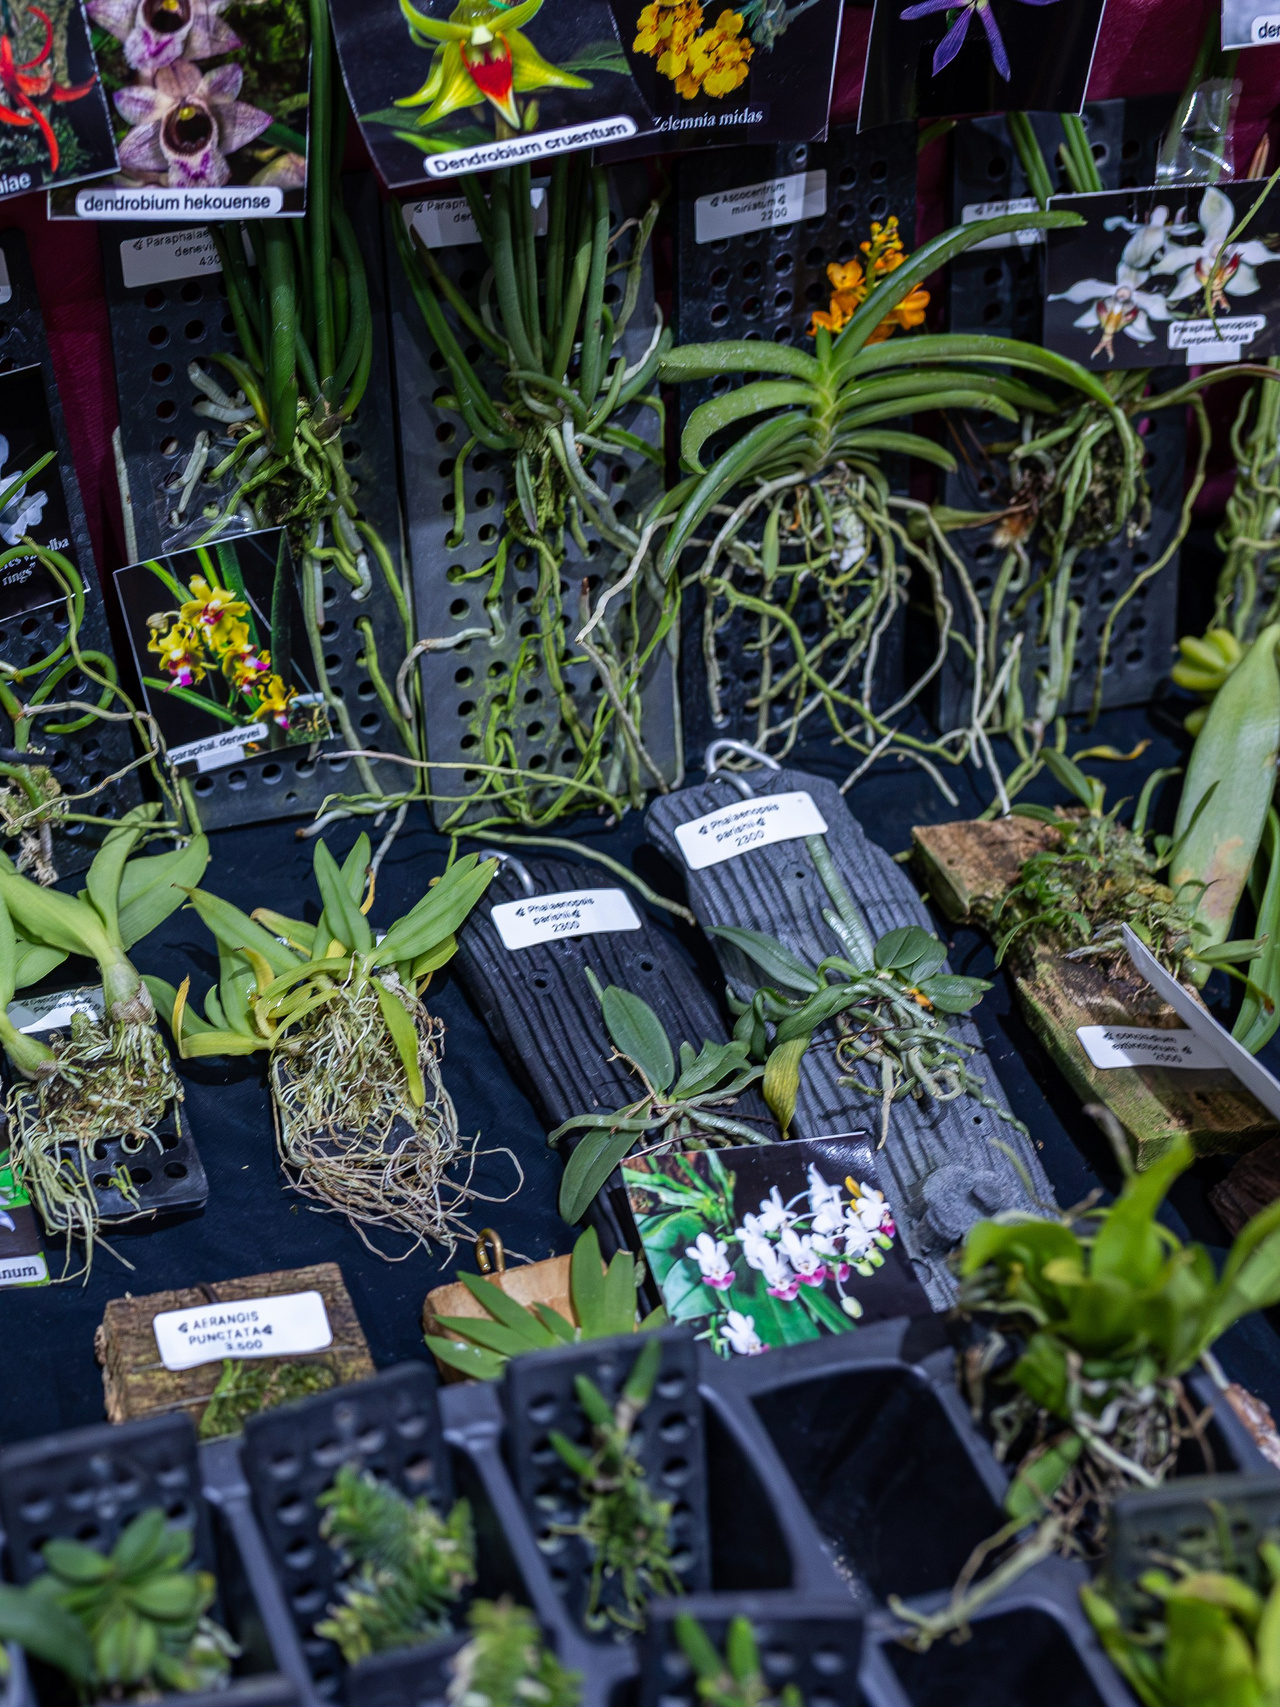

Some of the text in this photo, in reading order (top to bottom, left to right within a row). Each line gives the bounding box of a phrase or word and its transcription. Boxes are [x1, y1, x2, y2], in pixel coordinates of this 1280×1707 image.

[719, 107, 764, 126] midas
[433, 123, 628, 173] Dendrobium cruentum
[83, 194, 271, 213] dendrobium hekouense
[761, 207, 788, 222] 2200
[709, 802, 780, 830] Phalaenopsis
[735, 830, 765, 847] 2300
[527, 897, 595, 914] Phalaenopsis
[551, 920, 580, 933] 2300
[193, 1311, 260, 1330] AERANGIS
[188, 1326, 262, 1346] PUNCTATA
